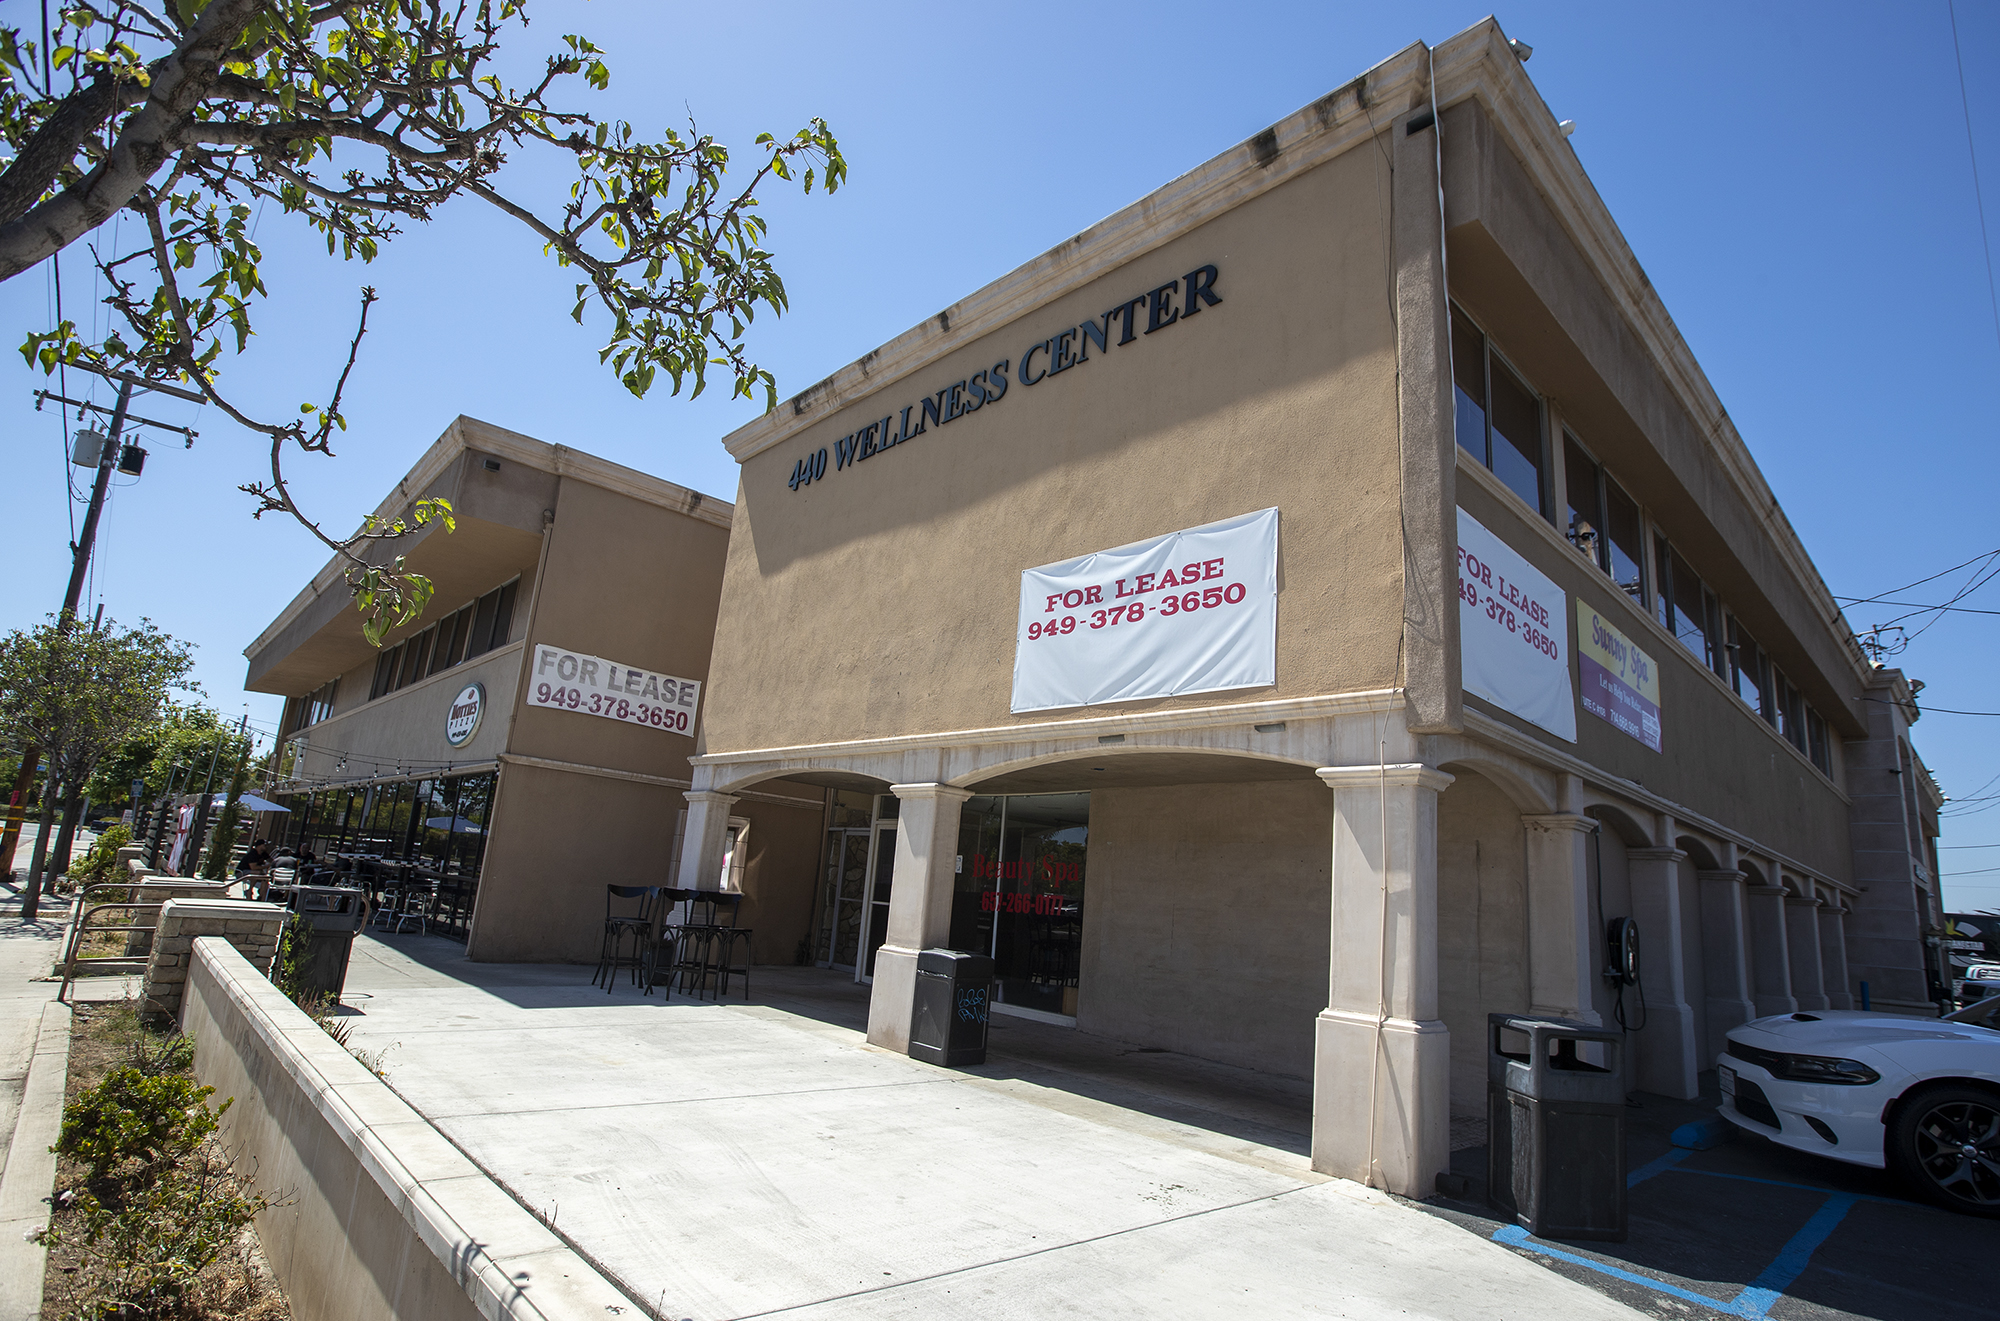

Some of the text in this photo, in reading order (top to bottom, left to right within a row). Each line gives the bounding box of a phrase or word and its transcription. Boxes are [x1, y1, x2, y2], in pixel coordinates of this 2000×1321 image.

[788, 264, 1223, 491] 440 WELLNESS CENTER
[1027, 582, 1247, 641] 949-378-3650
[1044, 557, 1225, 613] FOR LEASE
[1498, 576, 1549, 629] LEASE
[1458, 577, 1558, 661] 49-378-3650
[537, 650, 696, 708] FOR LEASE
[1592, 614, 1649, 691] Sunny Spa
[536, 682, 689, 731] 949-378-3650
[972, 854, 1080, 888] Beauty Spa
[981, 891, 1064, 916] 657-266-0177
